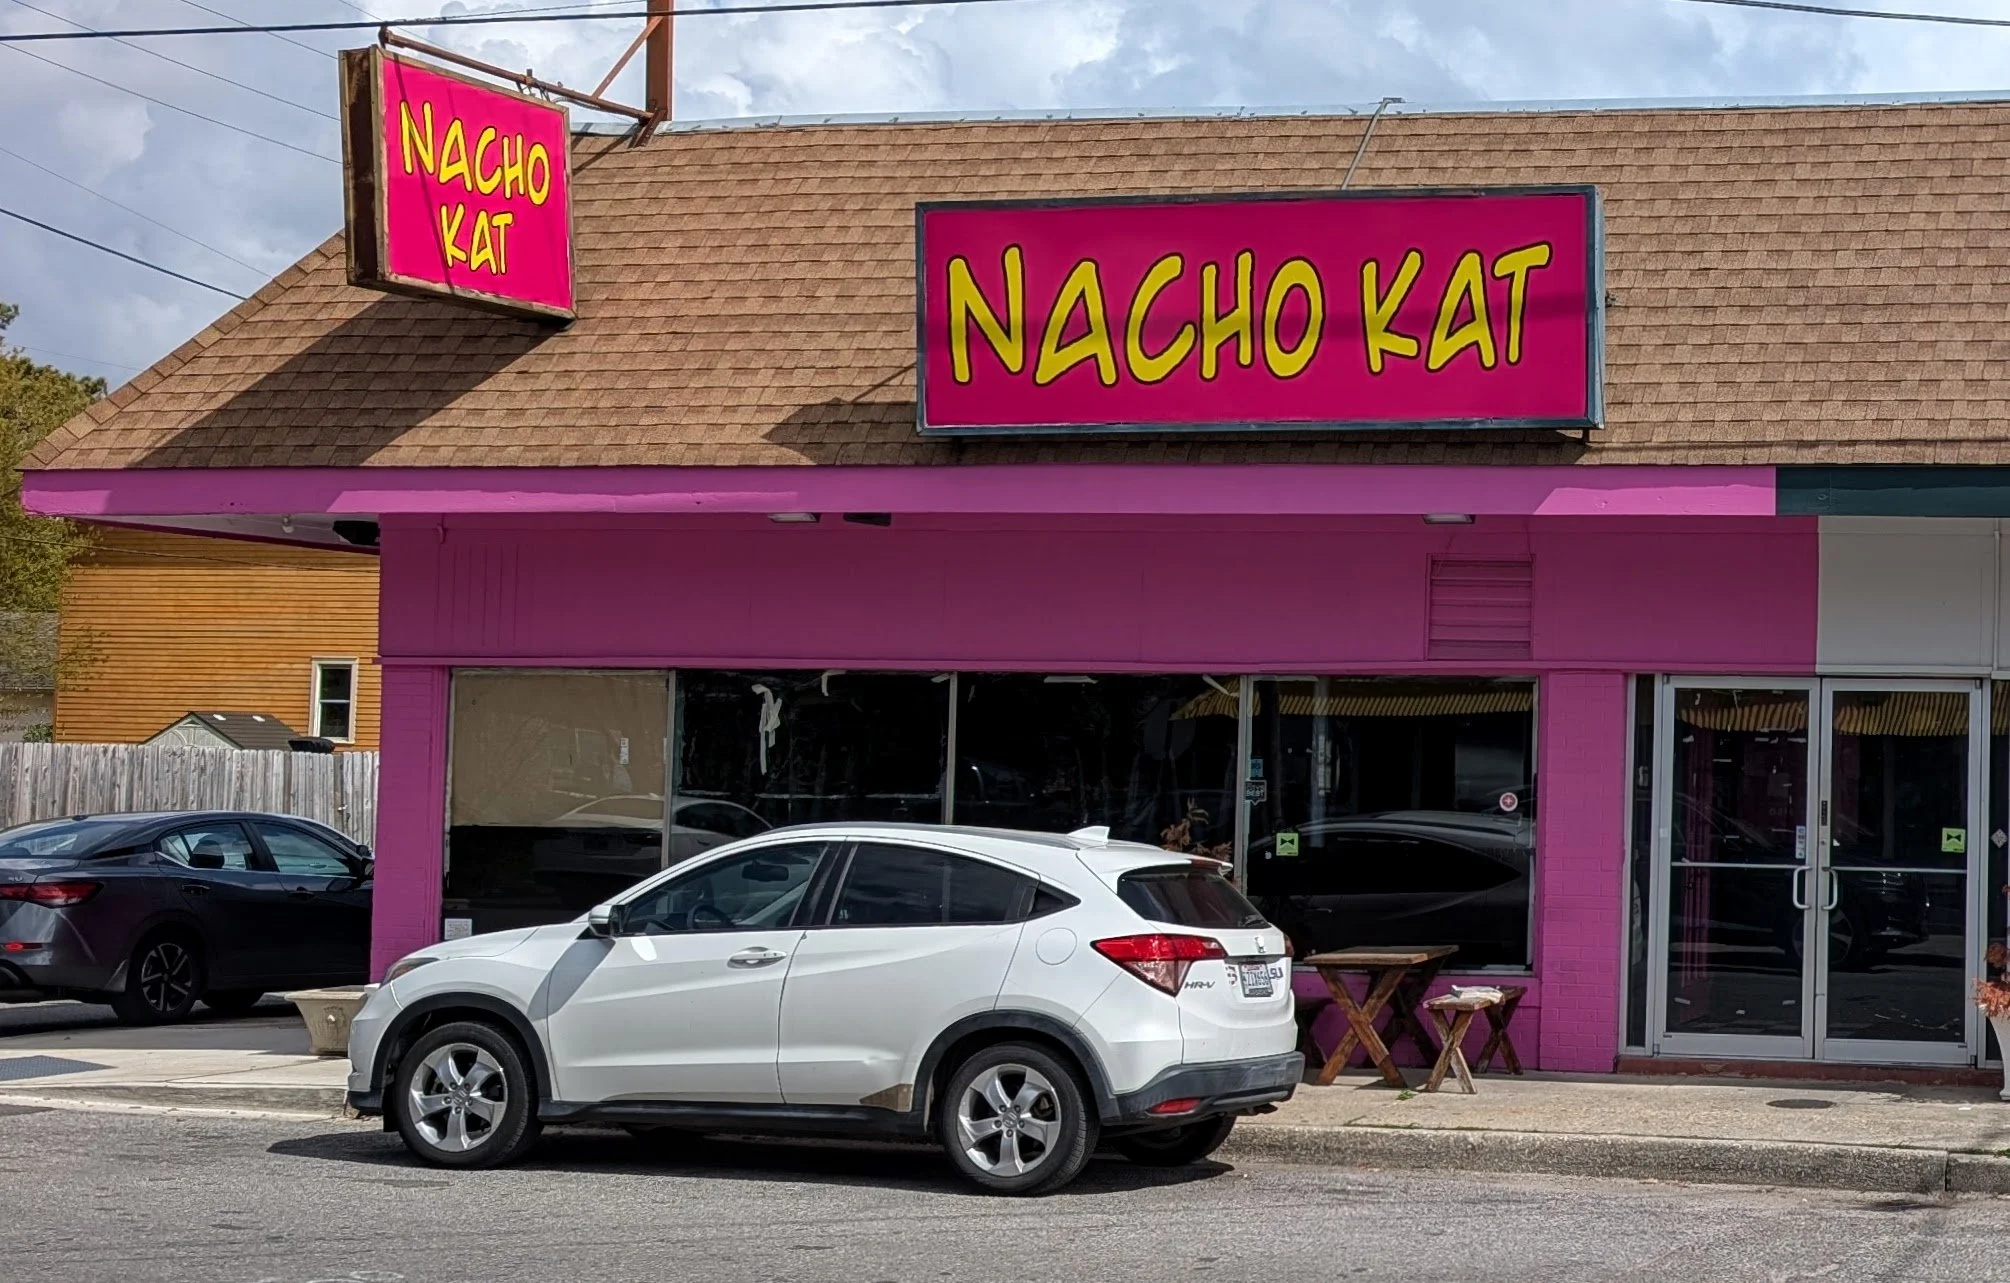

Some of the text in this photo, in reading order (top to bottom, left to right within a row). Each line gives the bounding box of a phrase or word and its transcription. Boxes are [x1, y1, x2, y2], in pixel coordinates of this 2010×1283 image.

[400, 101, 551, 206] NACHO
[440, 202, 515, 275] KAT
[946, 240, 1553, 387] NACHO KAT
[1184, 980, 1216, 989] HR-V
